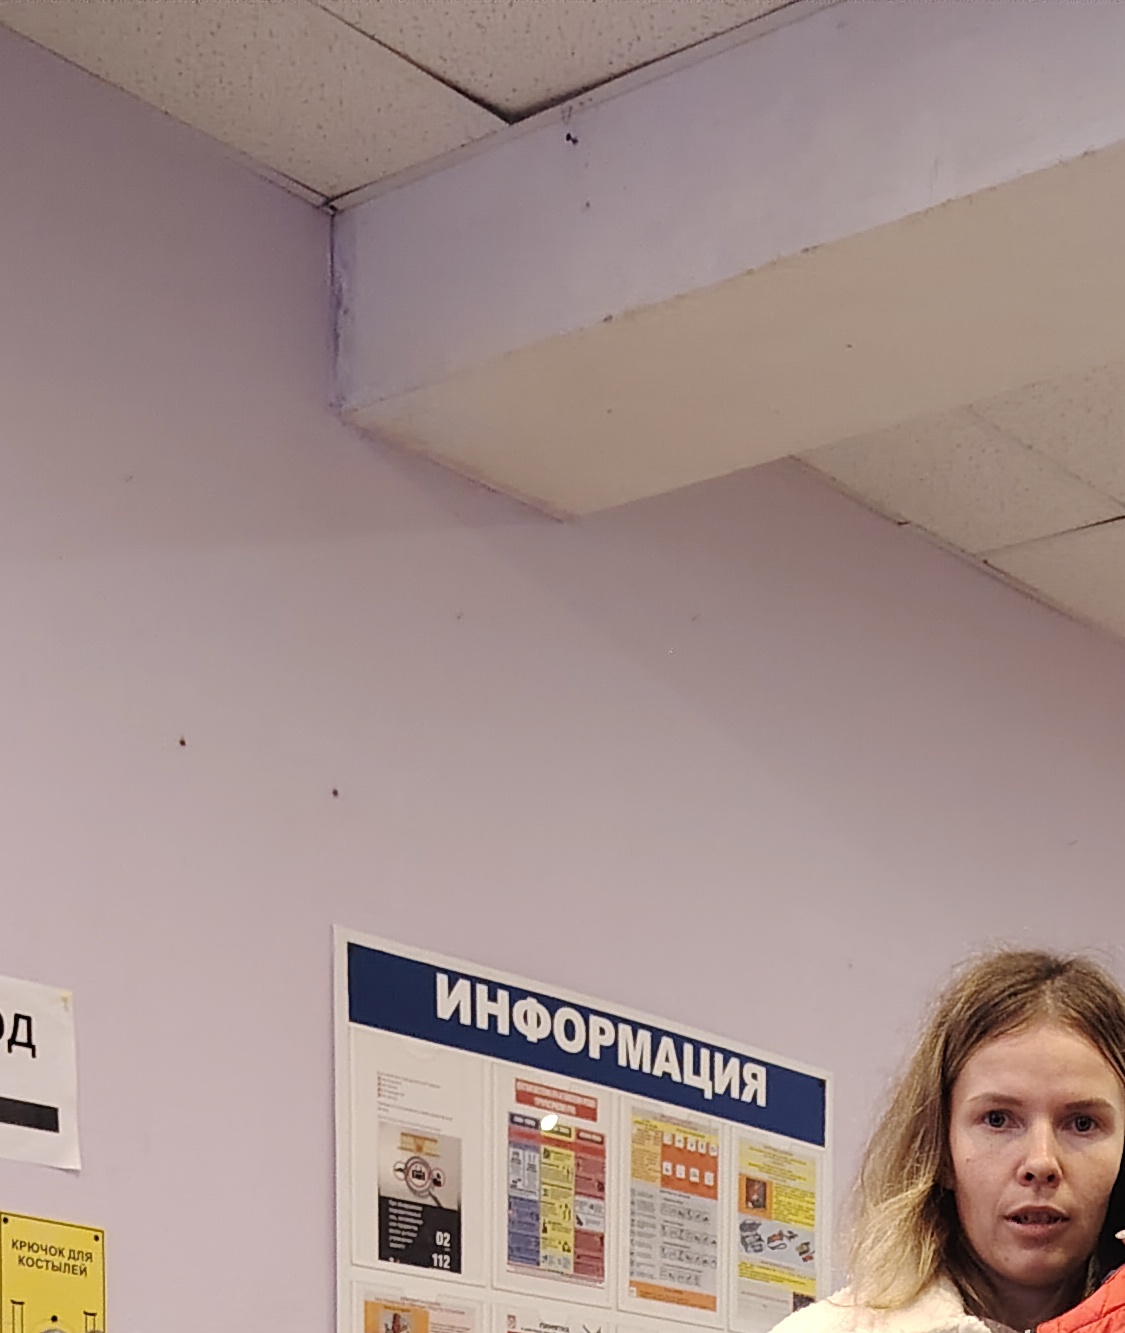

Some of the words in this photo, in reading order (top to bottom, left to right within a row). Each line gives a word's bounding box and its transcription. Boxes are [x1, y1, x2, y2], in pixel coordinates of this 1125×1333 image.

[0, 1012, 36, 1058] Д
[436, 972, 766, 1107] ИНФОРМАЦИЯ
[11, 1239, 65, 1258] КРЮЧОК
[68, 1249, 93, 1263] ДЛЯ
[436, 1231, 451, 1248] 02
[18, 1255, 87, 1277] КОСТЫЛЕЙ
[432, 1253, 451, 1269] 112
